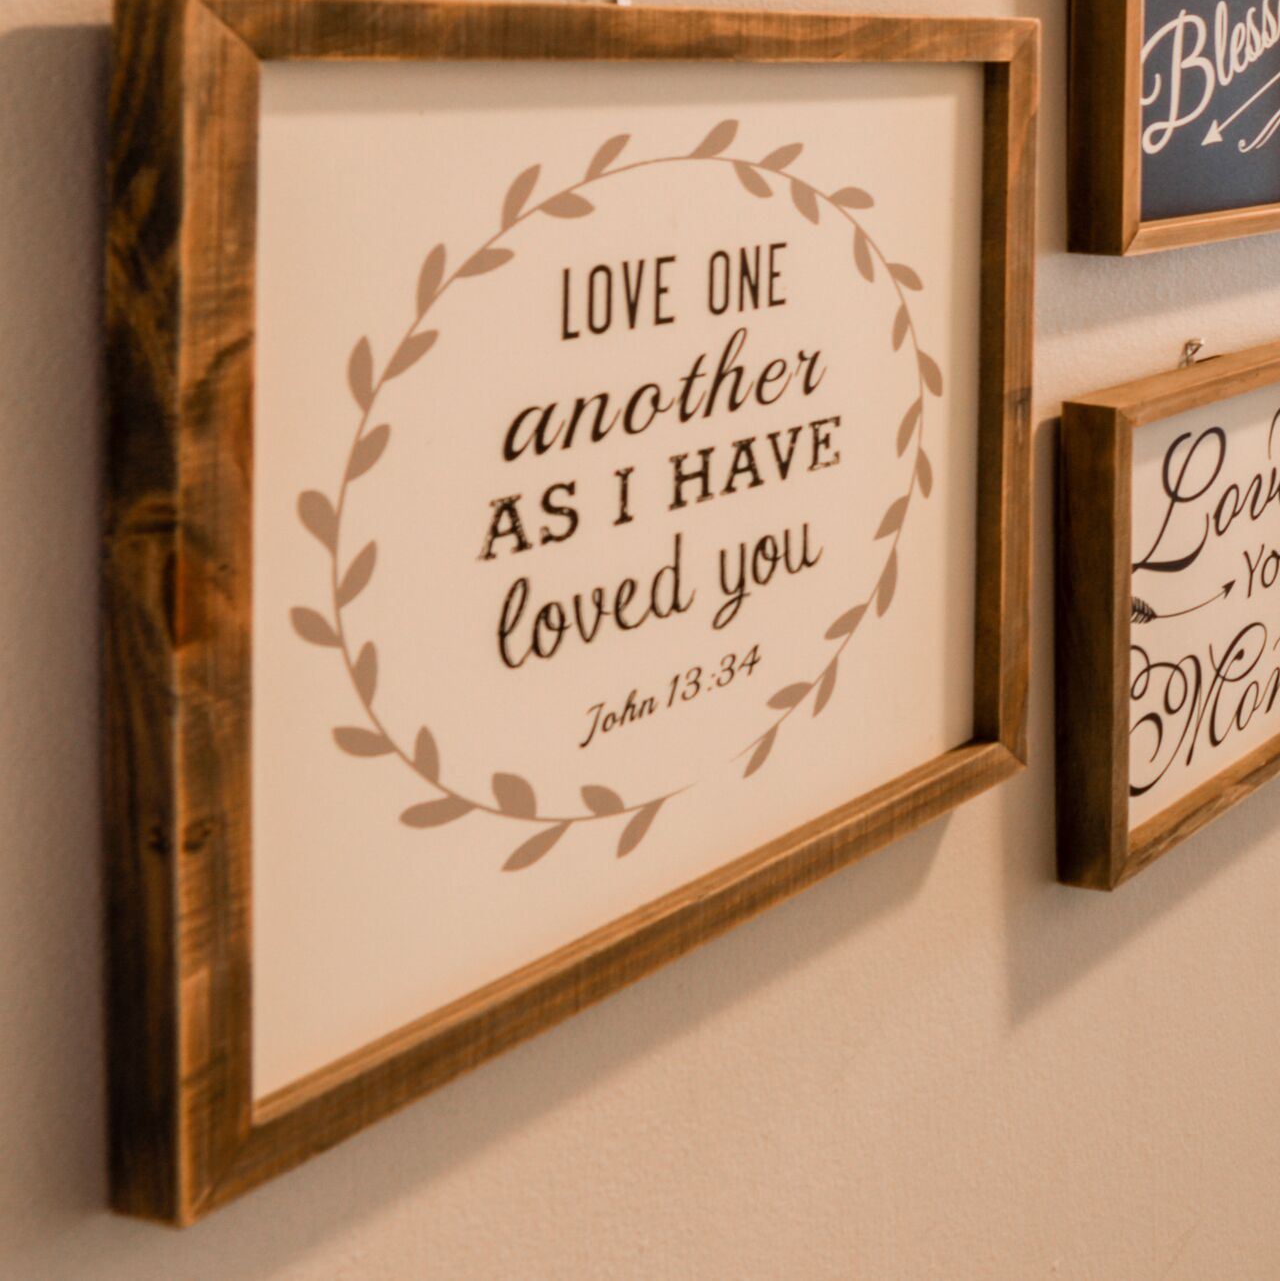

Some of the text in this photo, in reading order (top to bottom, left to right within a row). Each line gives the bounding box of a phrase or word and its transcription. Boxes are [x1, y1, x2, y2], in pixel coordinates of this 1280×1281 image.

[561, 242, 787, 341] LOVE ONE
[502, 327, 827, 462] another
[476, 416, 842, 561] AS I HAVE
[497, 523, 824, 670] loved you
[580, 644, 762, 748] John 13:34
